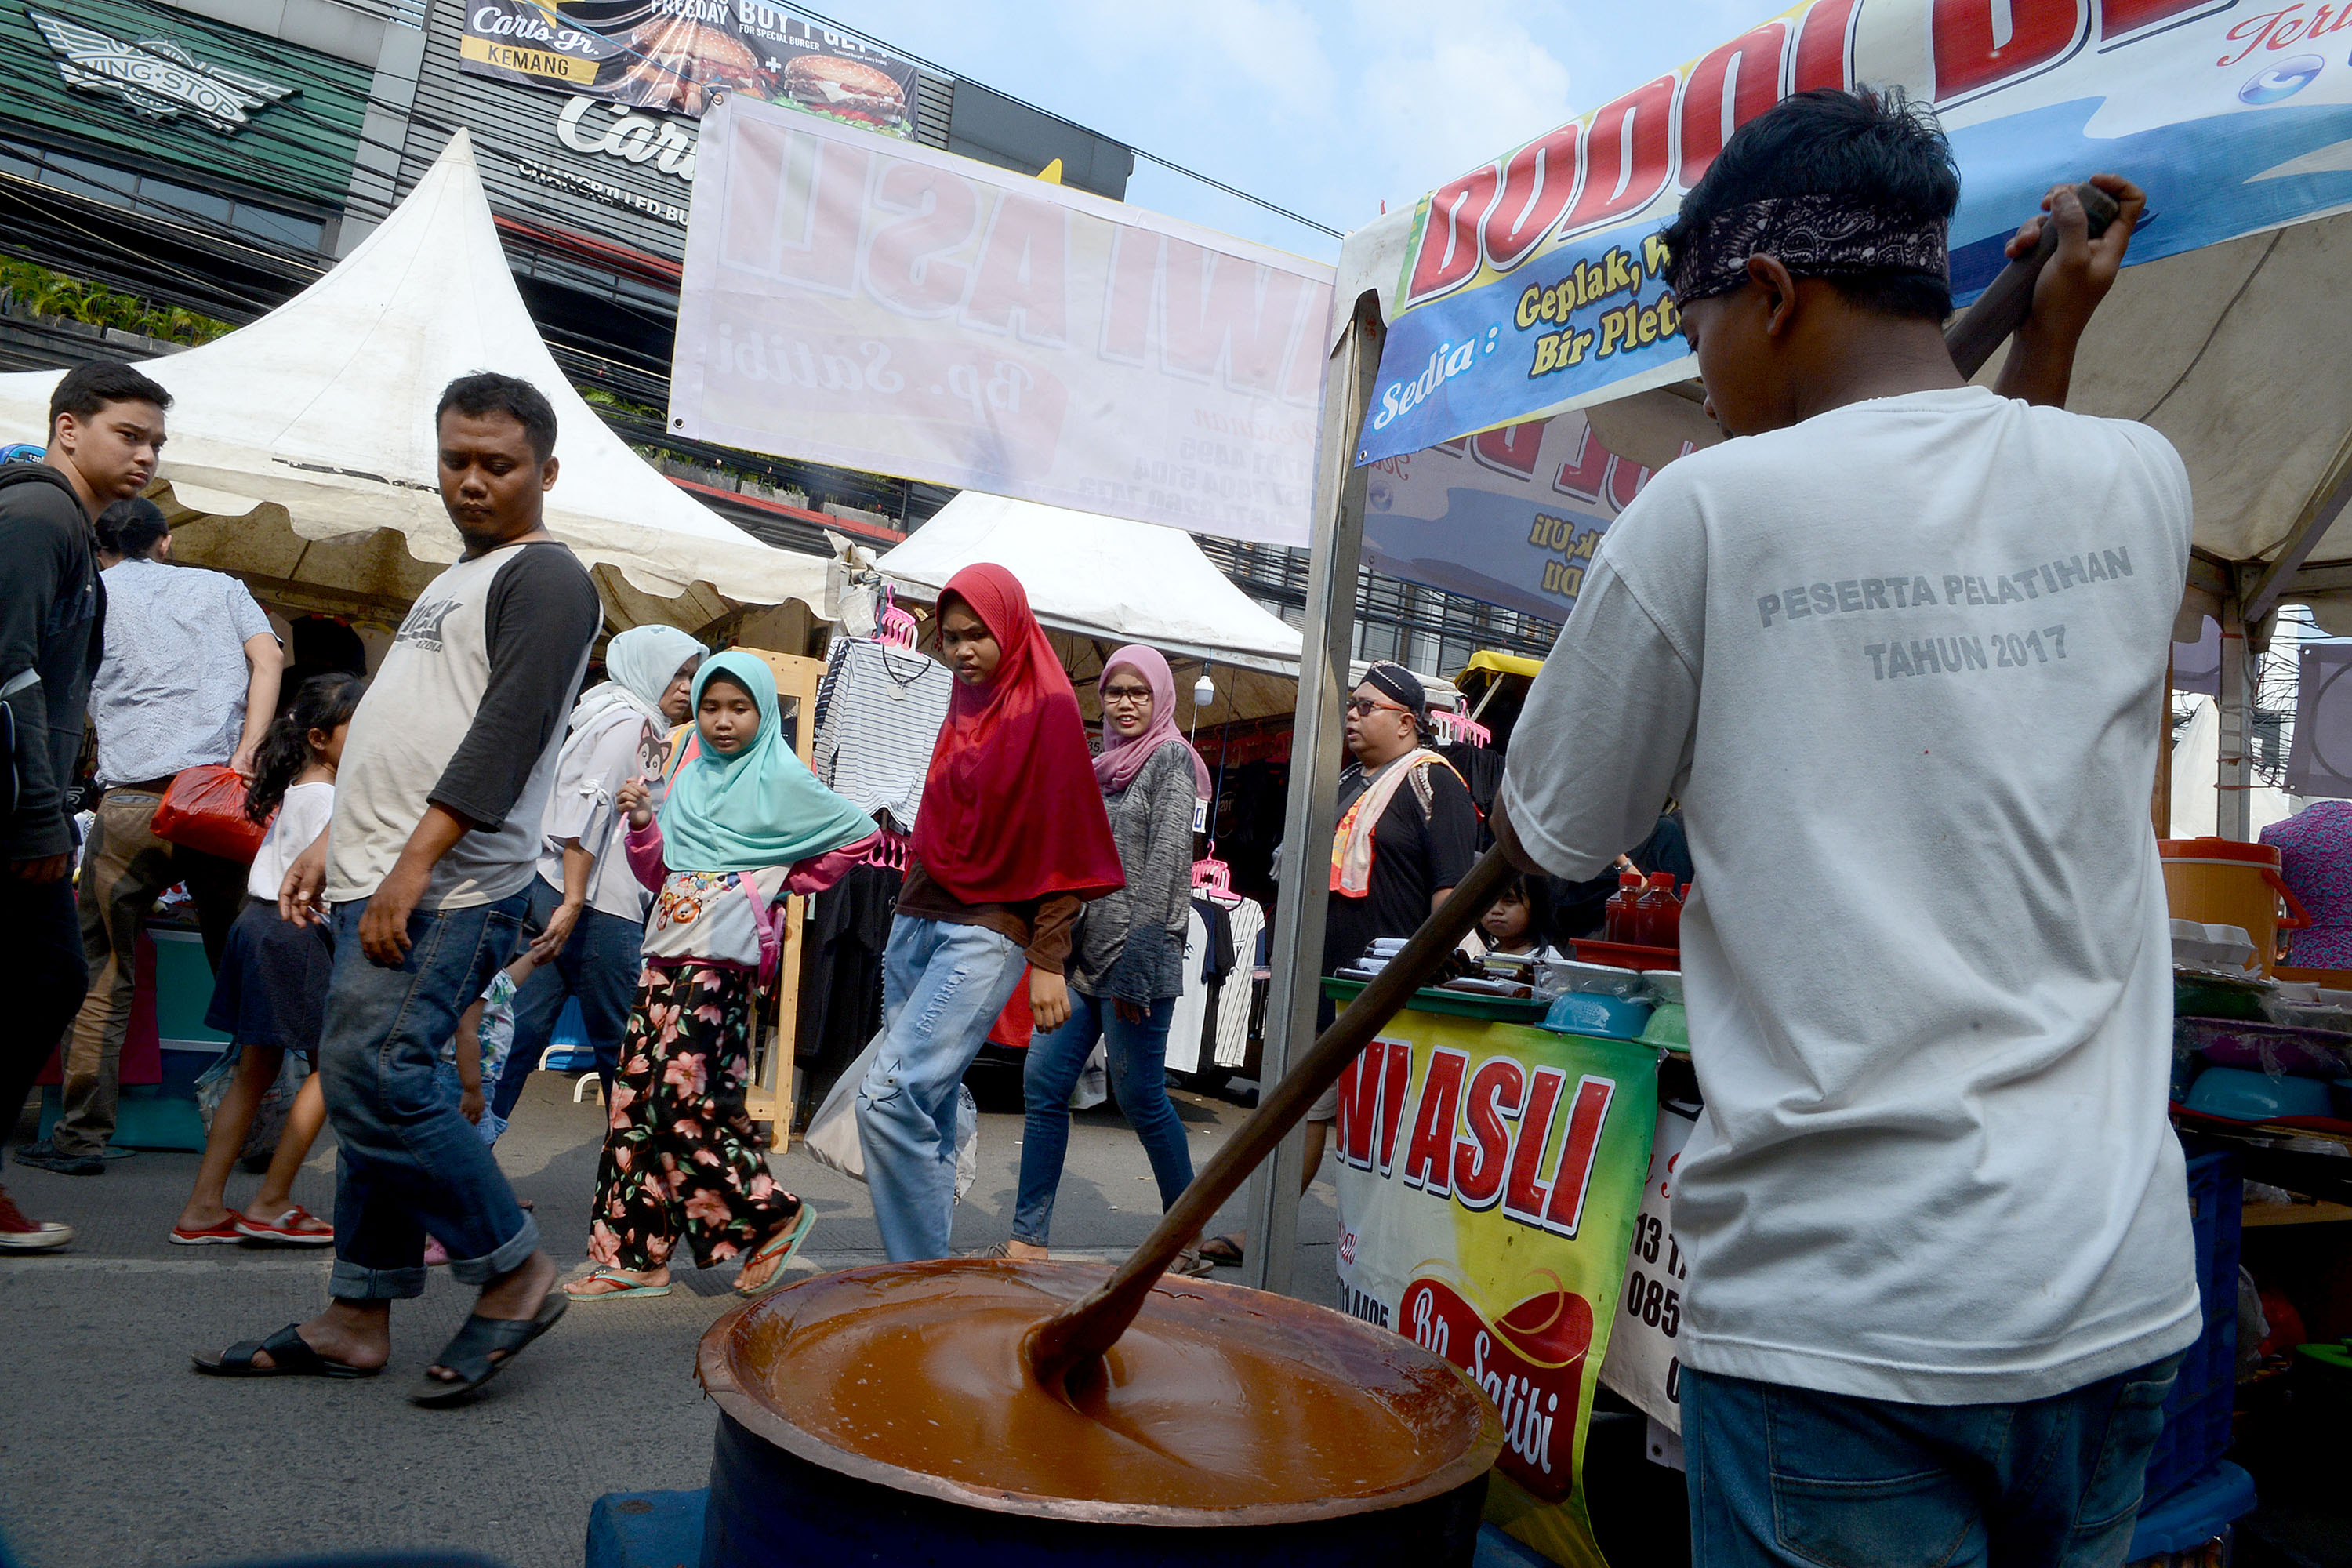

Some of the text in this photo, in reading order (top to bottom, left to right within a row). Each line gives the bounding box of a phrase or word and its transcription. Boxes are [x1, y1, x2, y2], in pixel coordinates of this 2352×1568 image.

[554, 29, 600, 56] Jr.
[739, 0, 789, 34] BUY
[739, 24, 755, 36] FOR
[757, 26, 788, 46] SPECIAL
[789, 36, 820, 52] BURGER
[488, 45, 569, 77] KEMANG
[666, 205, 689, 226] BU
[1515, 248, 1642, 329] Geplak,
[1530, 294, 1682, 377] Bir Plet
[1373, 337, 1475, 430] Sedia
[1757, 546, 2134, 628] PESERTA PELATIHAN
[1864, 624, 2067, 681] TAHUN 2017
[1403, 1045, 1616, 1240] ASLI
[1630, 1212, 1663, 1265] 13
[1466, 1330, 1558, 1474] Satibi
